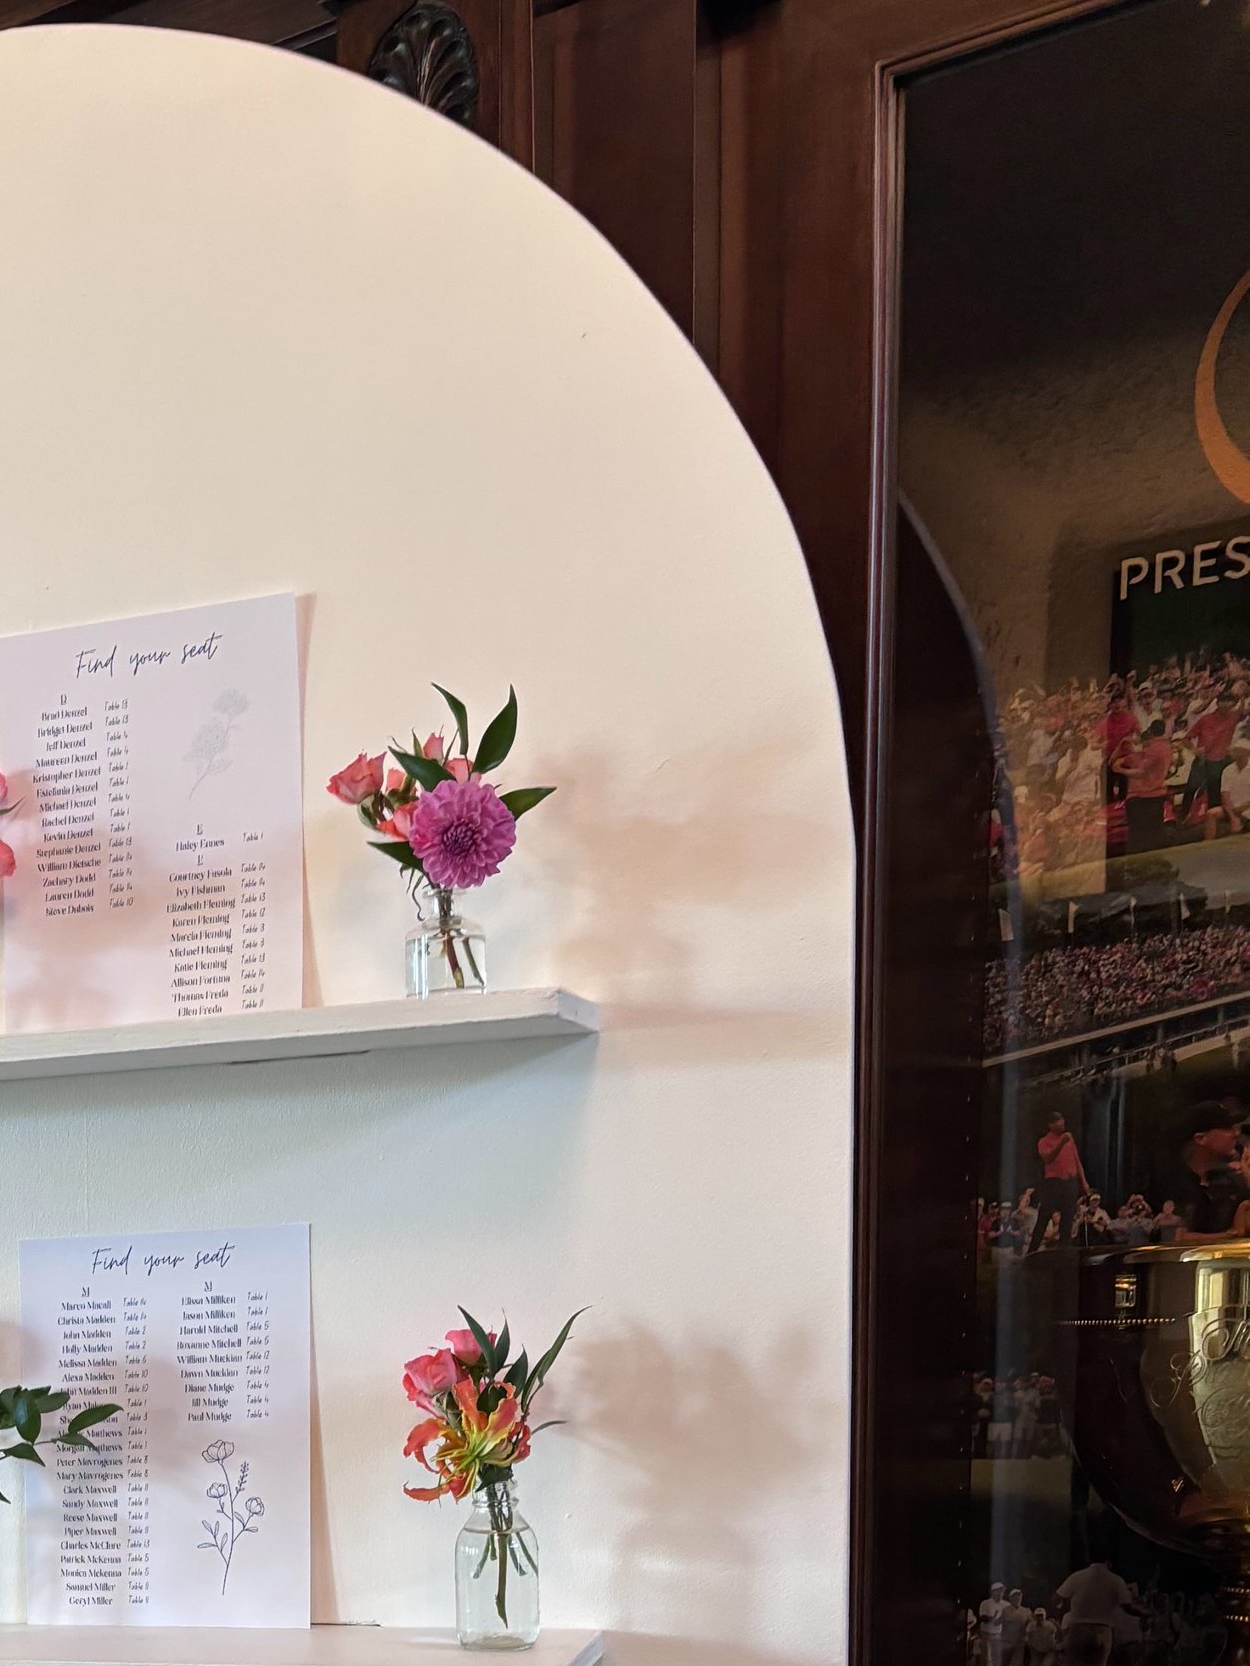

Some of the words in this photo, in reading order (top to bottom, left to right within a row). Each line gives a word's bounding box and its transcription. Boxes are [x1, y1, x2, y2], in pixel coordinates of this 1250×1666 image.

[75, 645, 116, 679] Find
[129, 650, 172, 676] your
[181, 631, 224, 664] seat
[32, 770, 73, 784] Kristopher
[75, 765, 101, 778] Denzel
[109, 762, 124, 772] Table
[37, 863, 68, 872] William
[109, 853, 124, 863] Table
[174, 962, 194, 973] Katie
[194, 959, 227, 971] Fleming
[241, 954, 257, 965] Table
[91, 1245, 131, 1275] Find
[143, 1253, 184, 1277] your
[194, 1242, 235, 1269] seat
[63, 1330, 80, 1339] John
[81, 1329, 111, 1339] Madden
[126, 1326, 140, 1335] Table
[180, 1325, 206, 1335] Harold
[208, 1324, 238, 1334] Mitchell
[247, 1321, 262, 1331] Table
[62, 1345, 80, 1355] Holly
[83, 1344, 113, 1353] Madden
[126, 1341, 140, 1350] Table
[59, 1359, 86, 1368] Melissa
[88, 1357, 117, 1367] Madden
[126, 1355, 140, 1364] Table
[177, 1355, 207, 1364] William
[246, 1351, 262, 1360] Table
[62, 1373, 83, 1382] Alexa
[85, 1372, 115, 1381] Madden
[125, 1370, 140, 1379] Table
[188, 1413, 204, 1421] Paul
[206, 1411, 232, 1422] Mudge
[247, 1409, 262, 1419] Table
[57, 1471, 75, 1483] Mary
[128, 1469, 142, 1478] Table
[62, 1499, 84, 1510] Sandy
[87, 1499, 118, 1508] Maxwell
[128, 1497, 142, 1507] Table
[63, 1513, 84, 1522] Reese
[86, 1513, 118, 1522] Maxwell
[128, 1511, 142, 1520] Table
